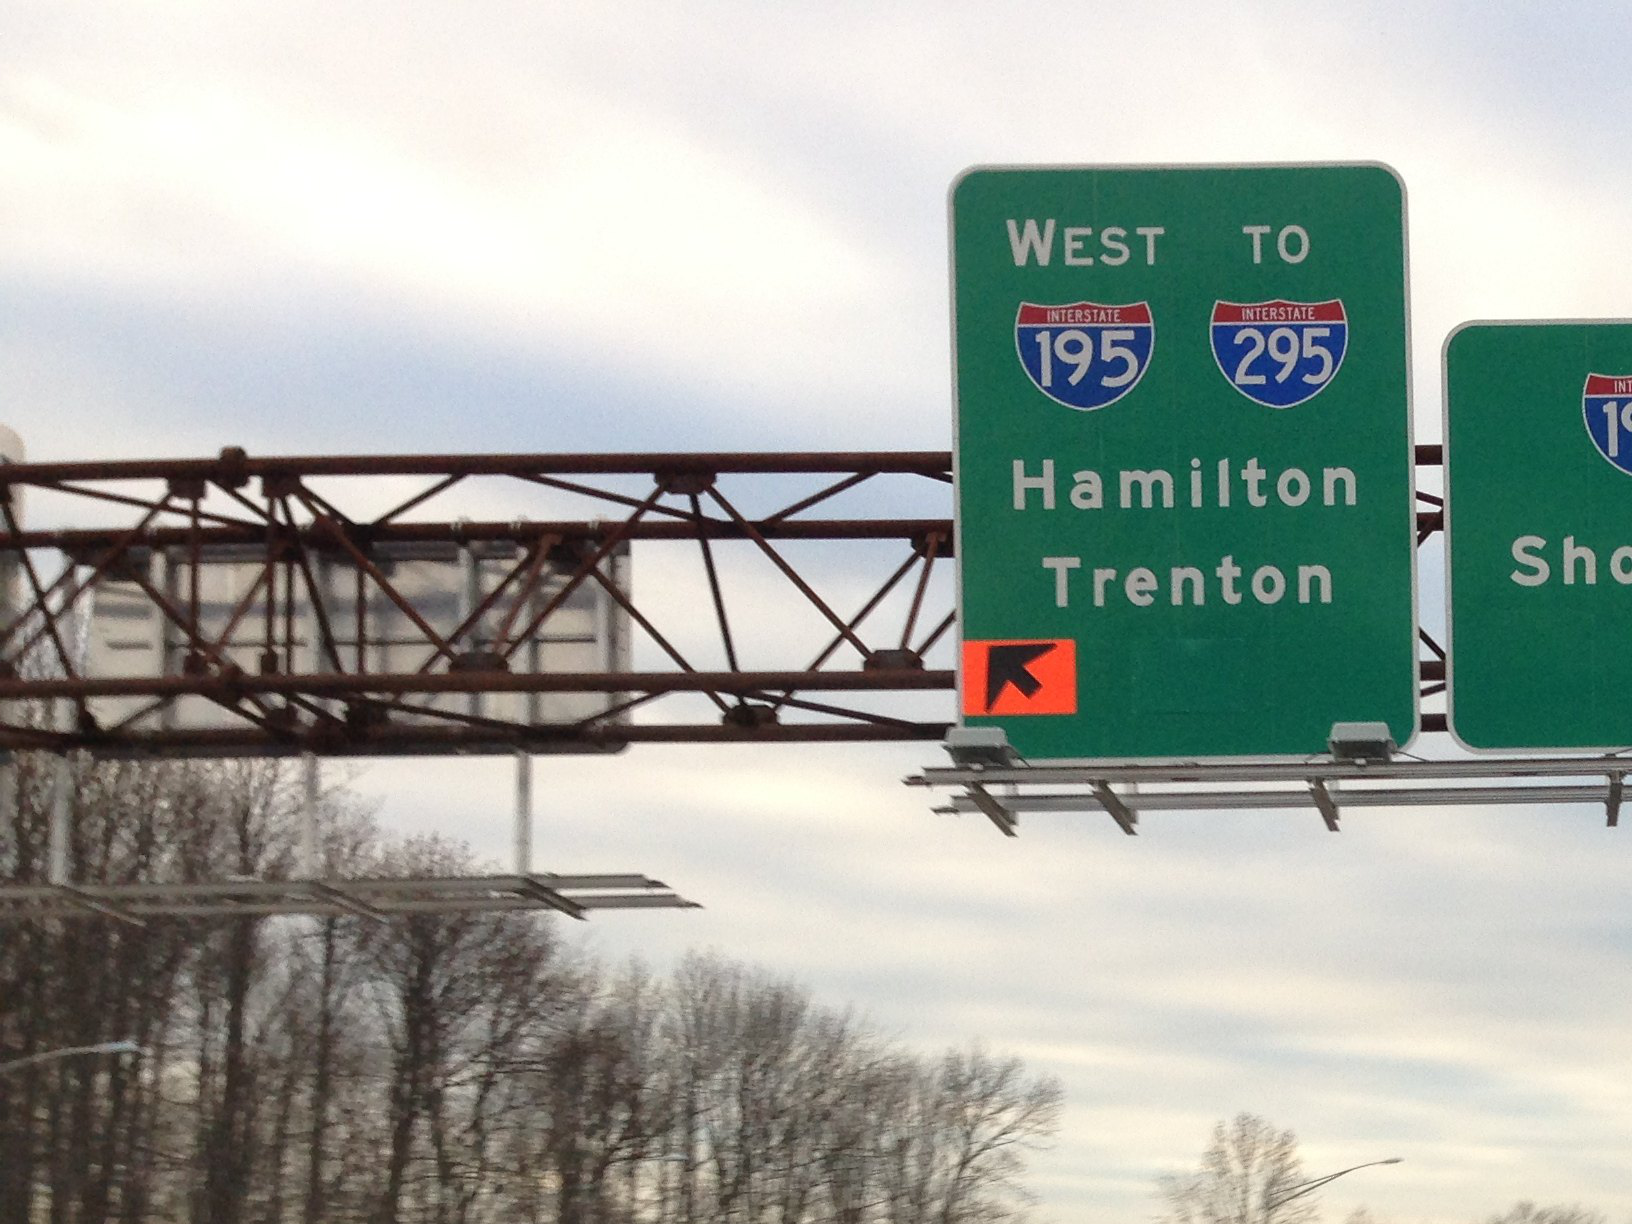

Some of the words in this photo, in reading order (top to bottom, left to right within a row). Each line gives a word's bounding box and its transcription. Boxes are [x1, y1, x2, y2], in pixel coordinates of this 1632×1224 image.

[1006, 219, 1164, 266] WEST
[1243, 225, 1310, 264] TO
[1047, 307, 1121, 322] INTERSTATE
[1242, 306, 1315, 321] INTERSTATE
[1035, 330, 1138, 388] 195
[1234, 327, 1333, 385] 295
[1012, 458, 1356, 510] Hamilton
[1043, 556, 1332, 608] Trenton
